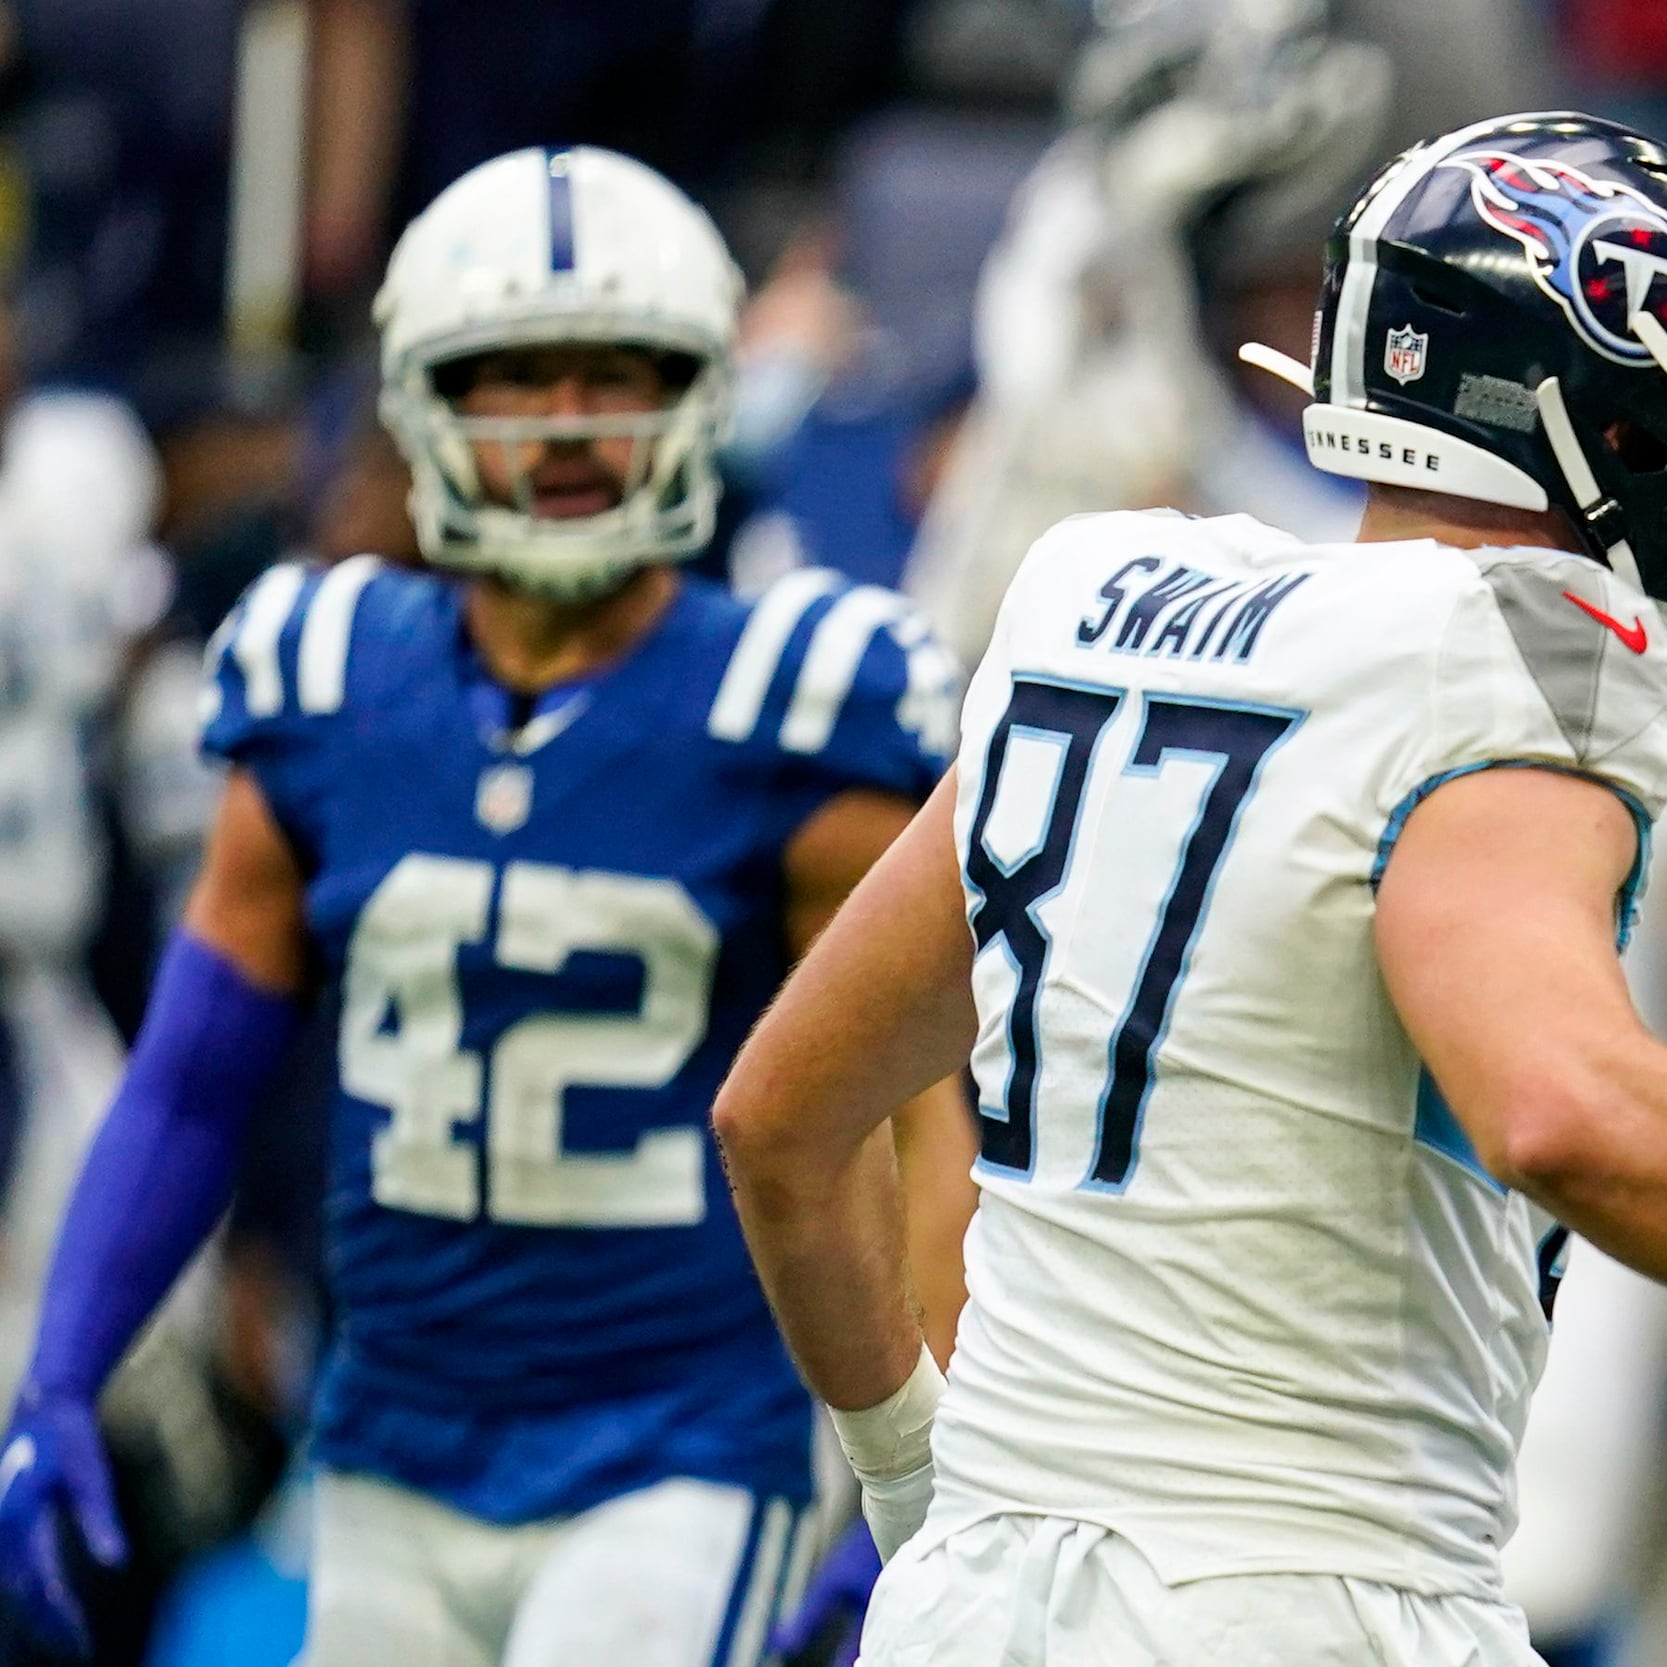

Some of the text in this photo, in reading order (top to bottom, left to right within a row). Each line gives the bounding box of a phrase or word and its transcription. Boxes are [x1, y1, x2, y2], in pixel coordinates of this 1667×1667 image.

[1391, 350, 1418, 374] NFL
[1075, 555, 1316, 665] SWAIM
[338, 851, 719, 1228] 42
[964, 670, 1310, 1194] 87
